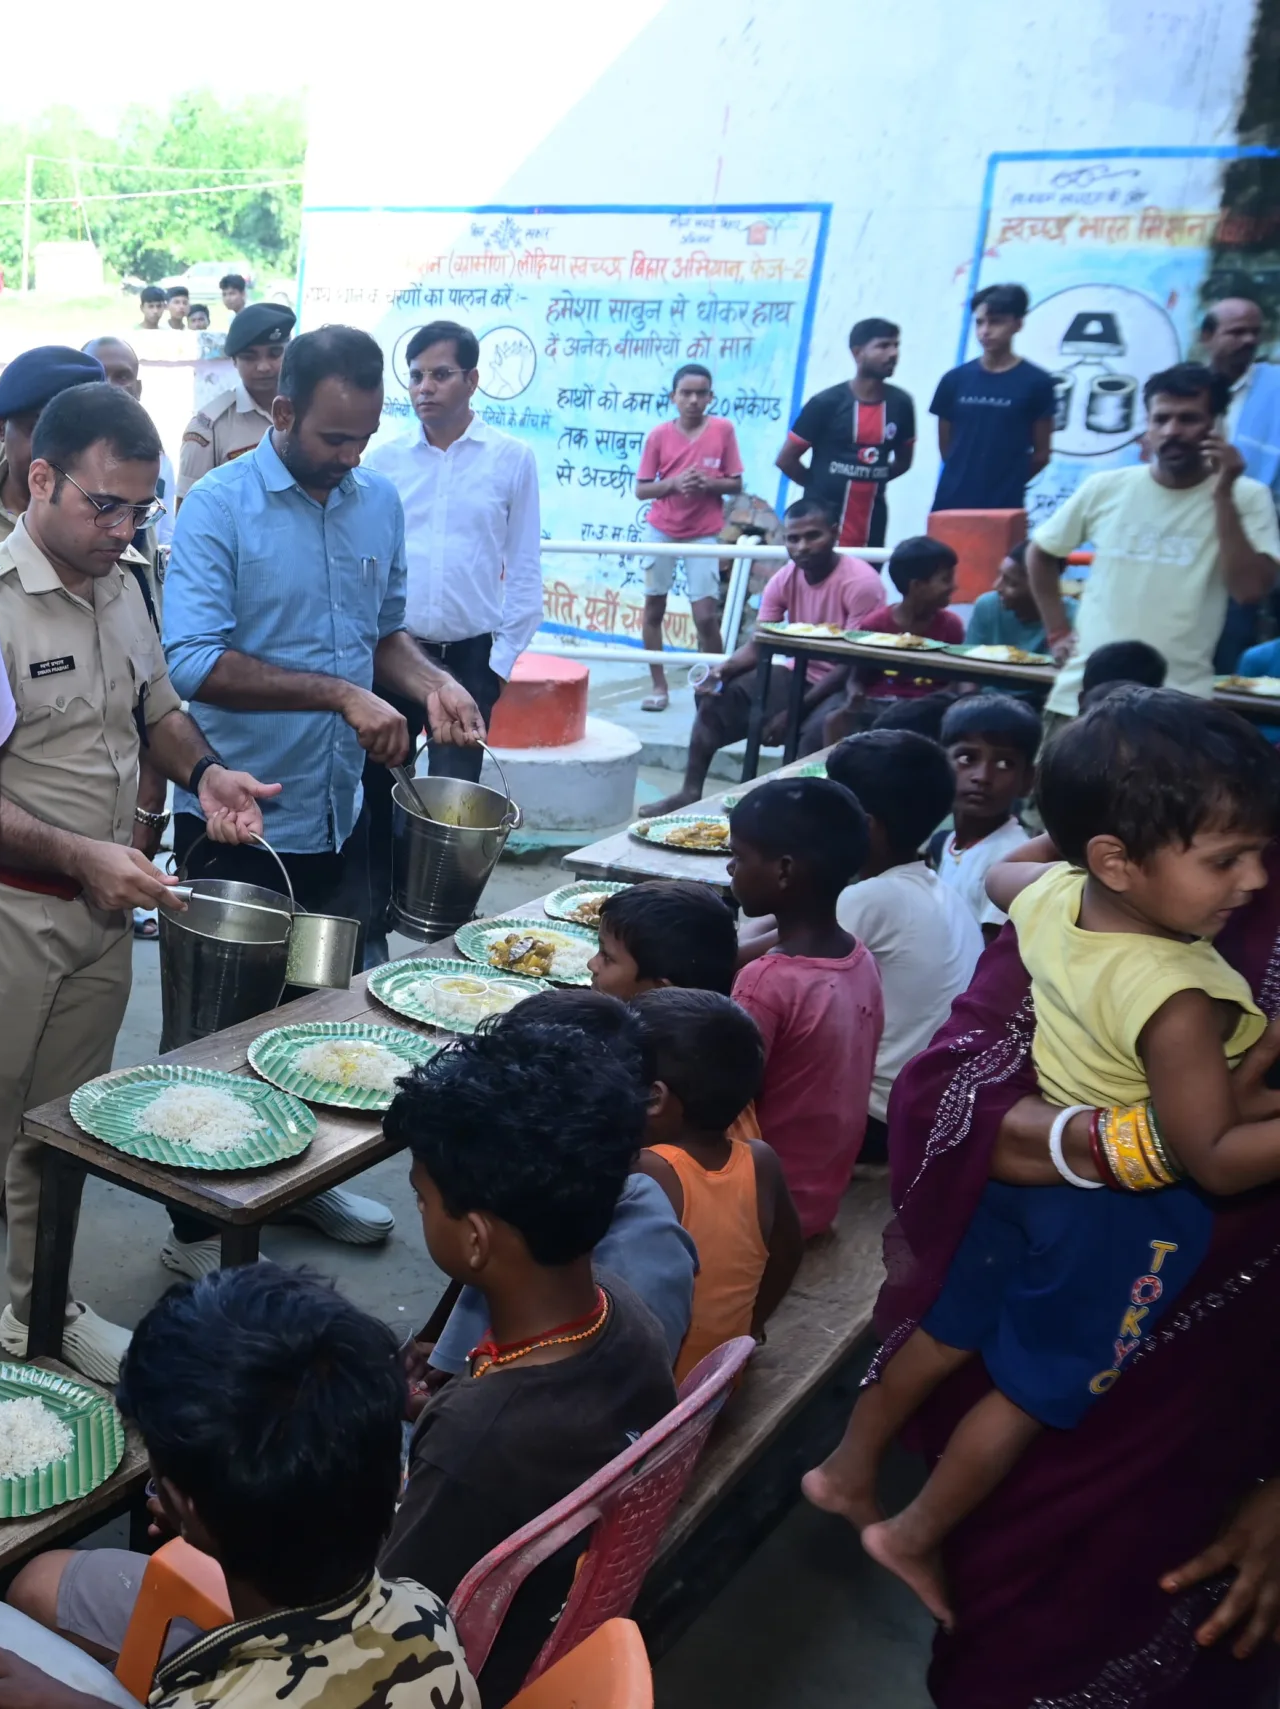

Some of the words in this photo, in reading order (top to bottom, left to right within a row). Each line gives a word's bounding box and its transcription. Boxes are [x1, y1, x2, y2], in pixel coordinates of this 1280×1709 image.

[631, 250, 670, 283] बिहार
[424, 289, 443, 308] का
[448, 288, 488, 312] पालन
[546, 289, 602, 324] हमेशा
[609, 299, 663, 332] साबुन
[670, 292, 690, 324] से
[697, 292, 751, 333] धोकर
[564, 331, 612, 359] अनेक
[686, 331, 713, 360] को
[557, 383, 595, 412] हाथों
[597, 383, 621, 414] को
[622, 390, 654, 415] कम
[557, 426, 588, 451] तक
[595, 428, 645, 460] साबुन
[556, 458, 574, 487] से
[1089, 1239, 1179, 1395] TOKYO
